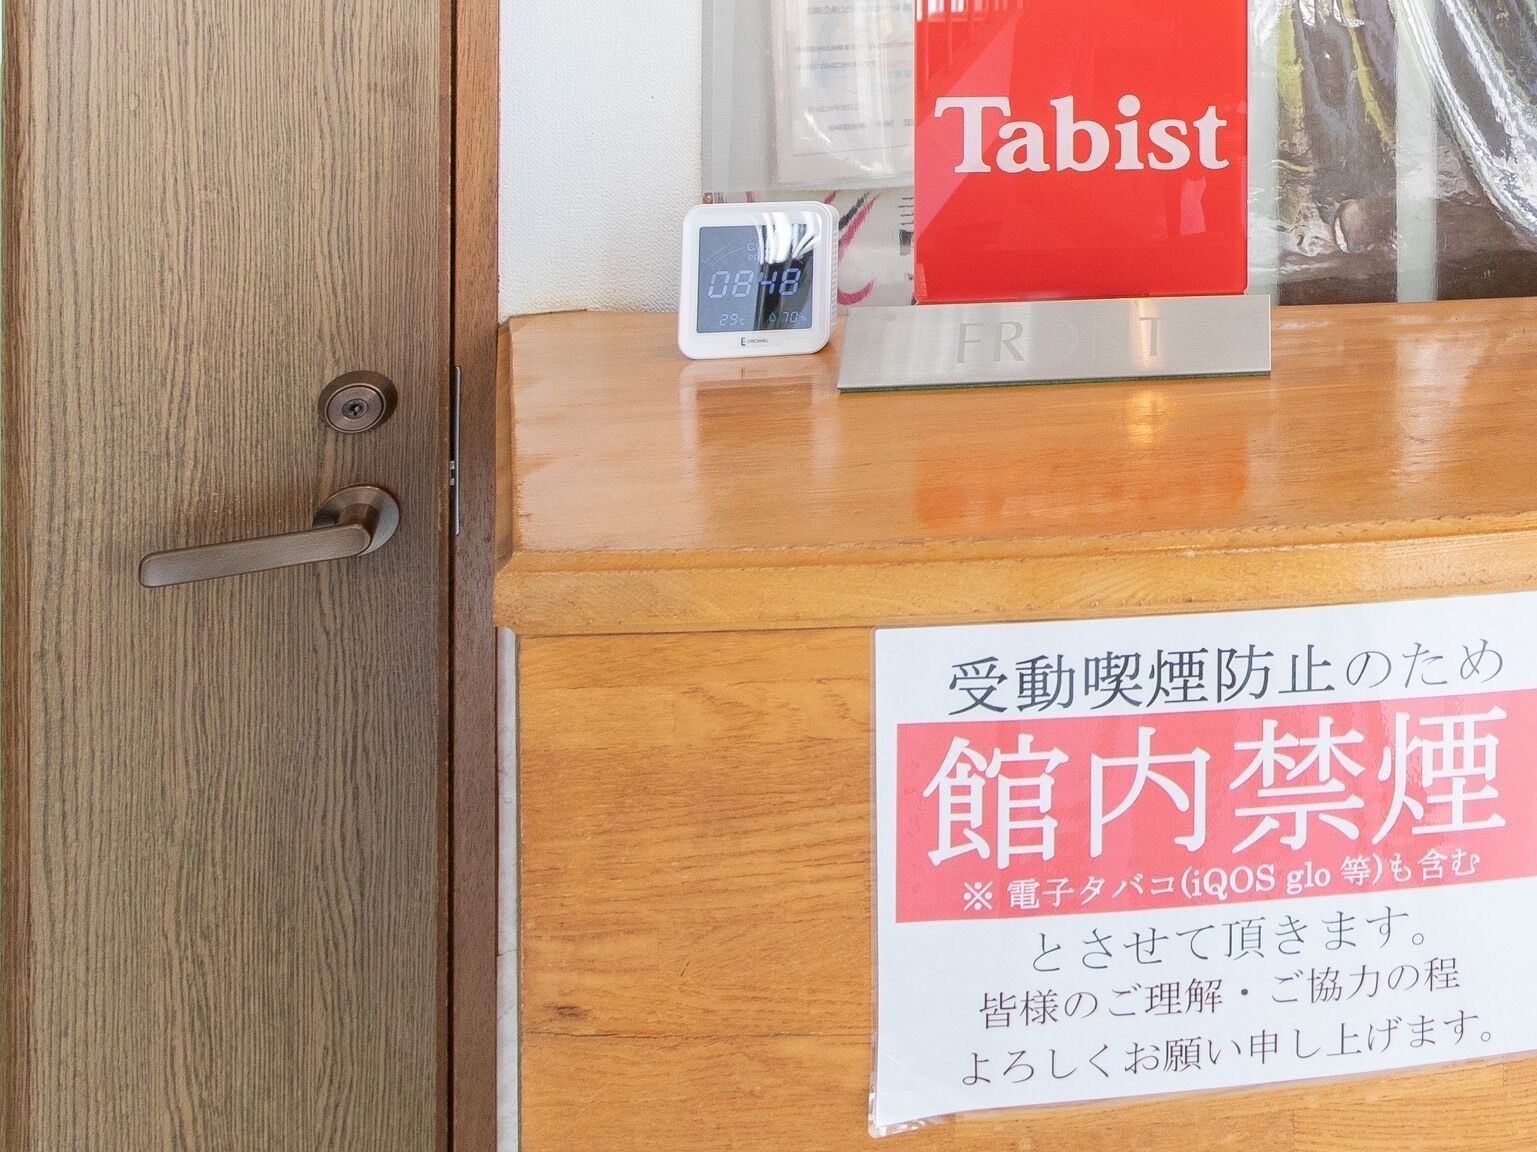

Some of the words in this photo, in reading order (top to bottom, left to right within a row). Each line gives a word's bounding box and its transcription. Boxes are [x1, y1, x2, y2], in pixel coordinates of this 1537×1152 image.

[934, 94, 1230, 174] Tabist
[947, 637, 1504, 717] 受動喫煙防止のため
[922, 705, 1508, 871] 館内禁煙
[1285, 864, 1330, 896] glo
[1031, 904, 1427, 974] とさせて頂きます。
[978, 957, 1462, 1029] 皆様のご理解・ご協力の程
[961, 1008, 1494, 1087] よろしくお願い申し上げます。
